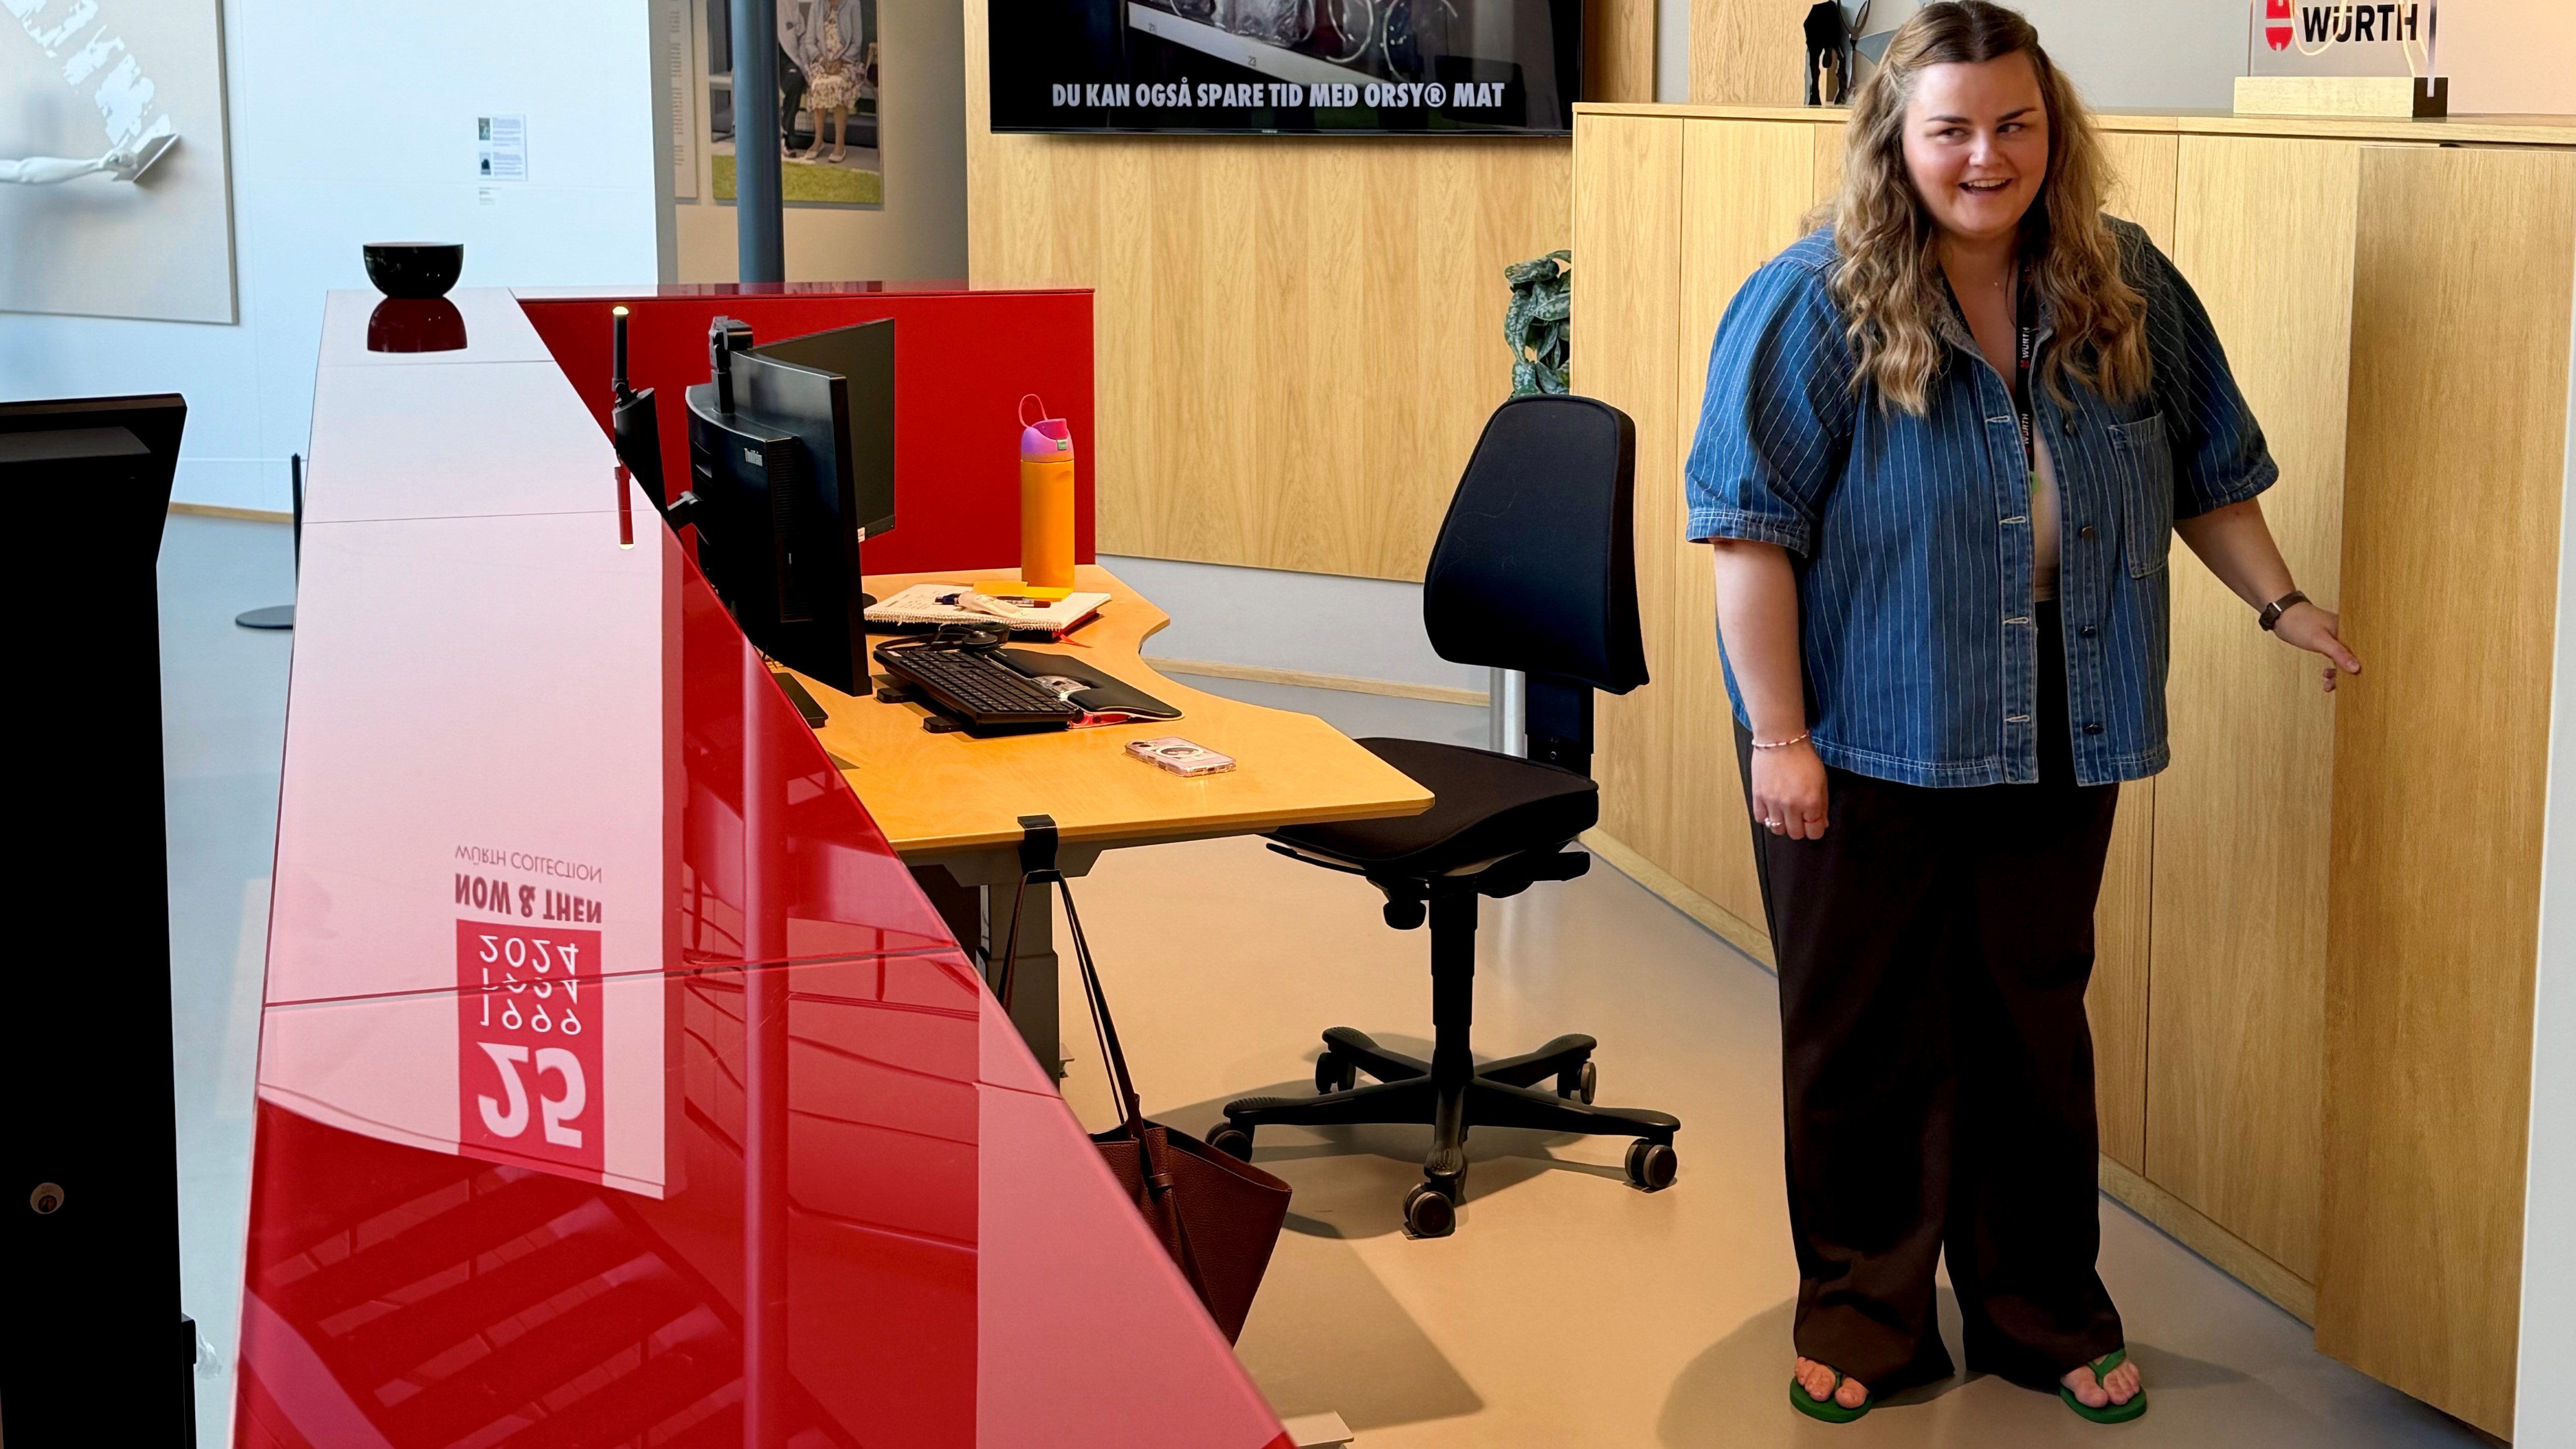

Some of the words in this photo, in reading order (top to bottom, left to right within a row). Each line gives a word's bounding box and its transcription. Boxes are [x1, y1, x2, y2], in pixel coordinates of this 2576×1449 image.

[2302, 3, 2418, 43] WÜRTH
[1052, 83, 1081, 107] DU
[1086, 83, 1130, 107] KAN
[1135, 76, 1193, 107] OGSÅ
[1197, 83, 1264, 107] SPARE
[1268, 83, 1304, 107] TID
[1308, 82, 1359, 107] MED
[1452, 82, 1505, 107] MAT
